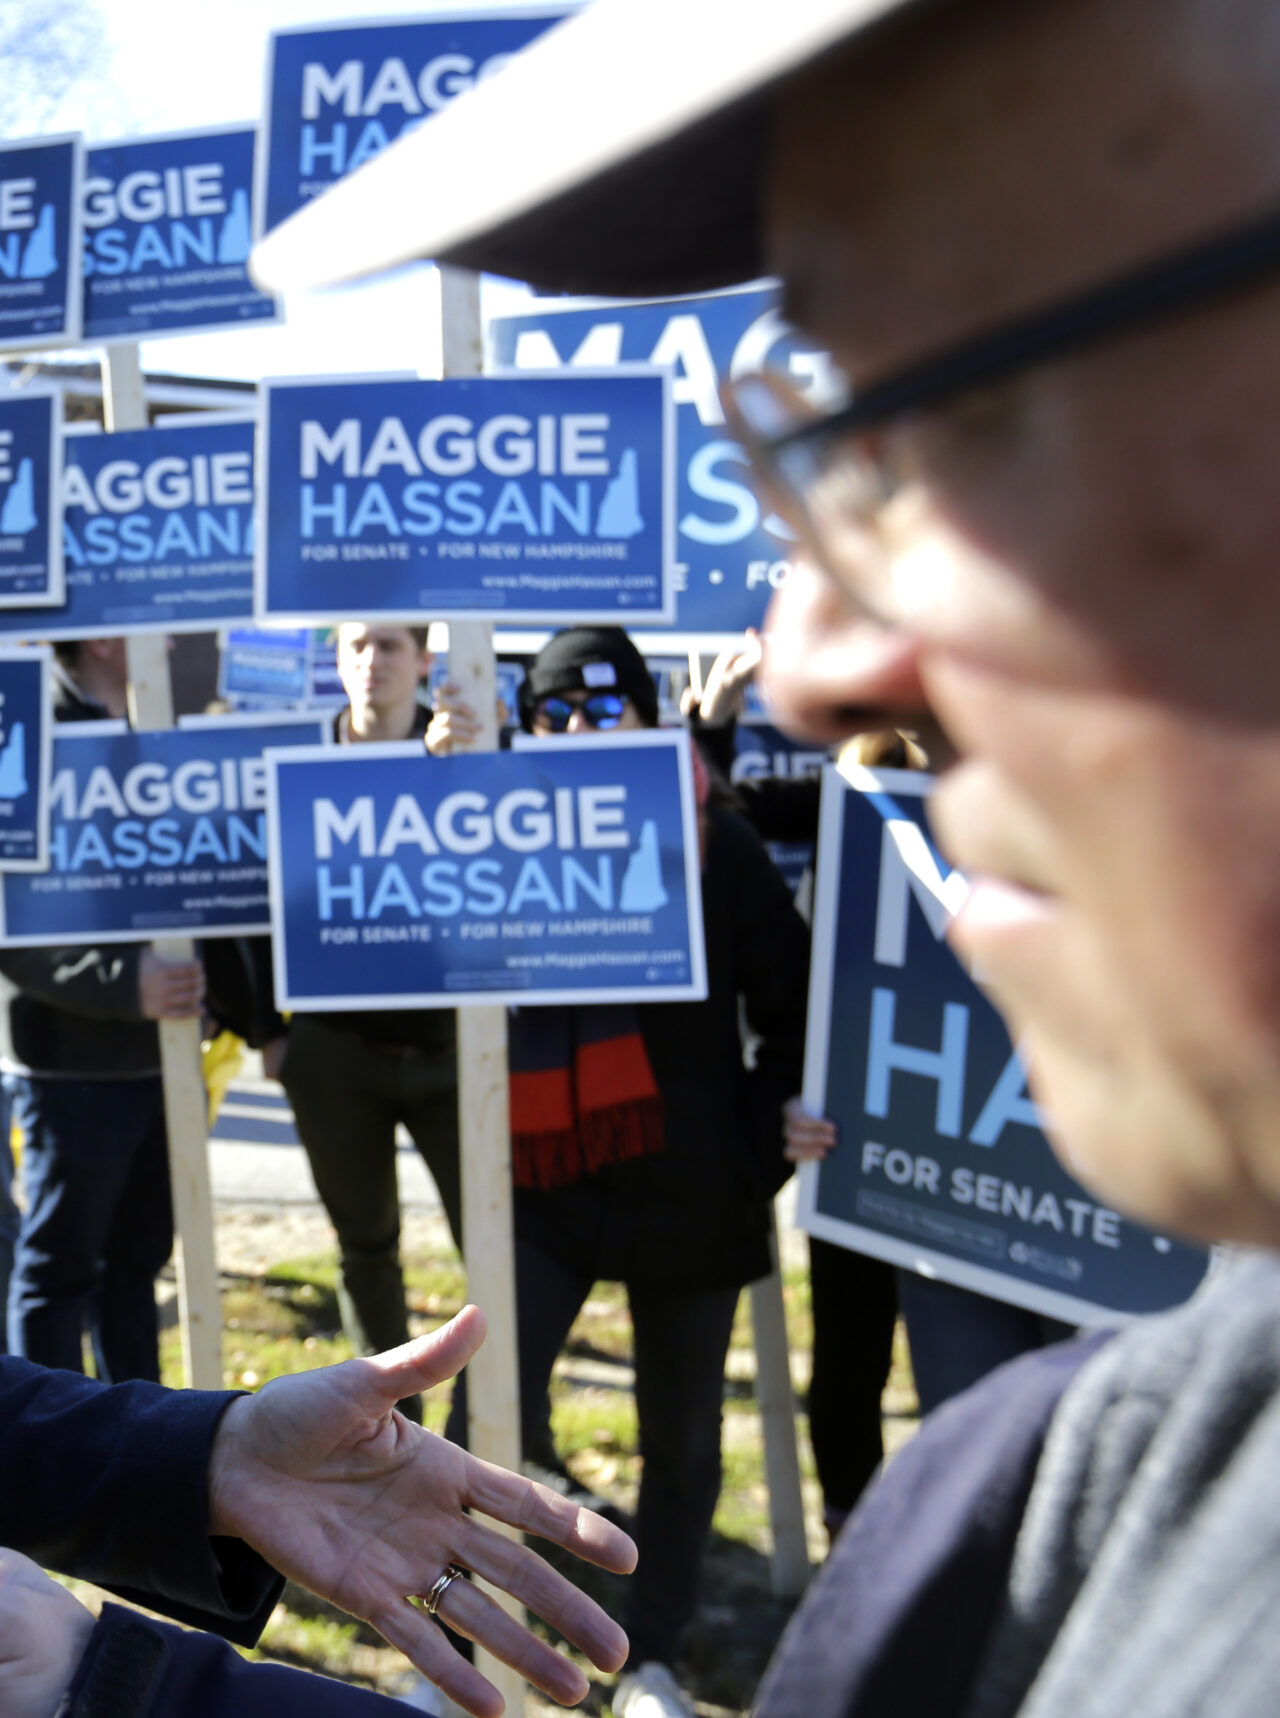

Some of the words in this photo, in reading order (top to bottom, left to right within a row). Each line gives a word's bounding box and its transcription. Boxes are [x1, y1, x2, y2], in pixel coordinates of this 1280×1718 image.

[301, 53, 517, 120] MAG
[299, 414, 610, 479] MAGGIE
[299, 481, 591, 538] HASSAN
[300, 543, 339, 562] FOR
[341, 541, 410, 561] SENATE
[437, 541, 476, 560] FOR
[478, 541, 521, 560] NEW
[524, 541, 628, 561] HAMPSHIRE
[313, 785, 629, 859] MAGGIE
[317, 854, 614, 921] HASSAN
[320, 927, 358, 946] FOR
[362, 924, 432, 944] SENATE
[461, 921, 498, 940] FOR
[501, 919, 545, 939] NEW
[548, 916, 654, 938] HAMPSHIRE
[861, 1141, 941, 1195] FOR
[950, 1167, 1122, 1250] SENATE
